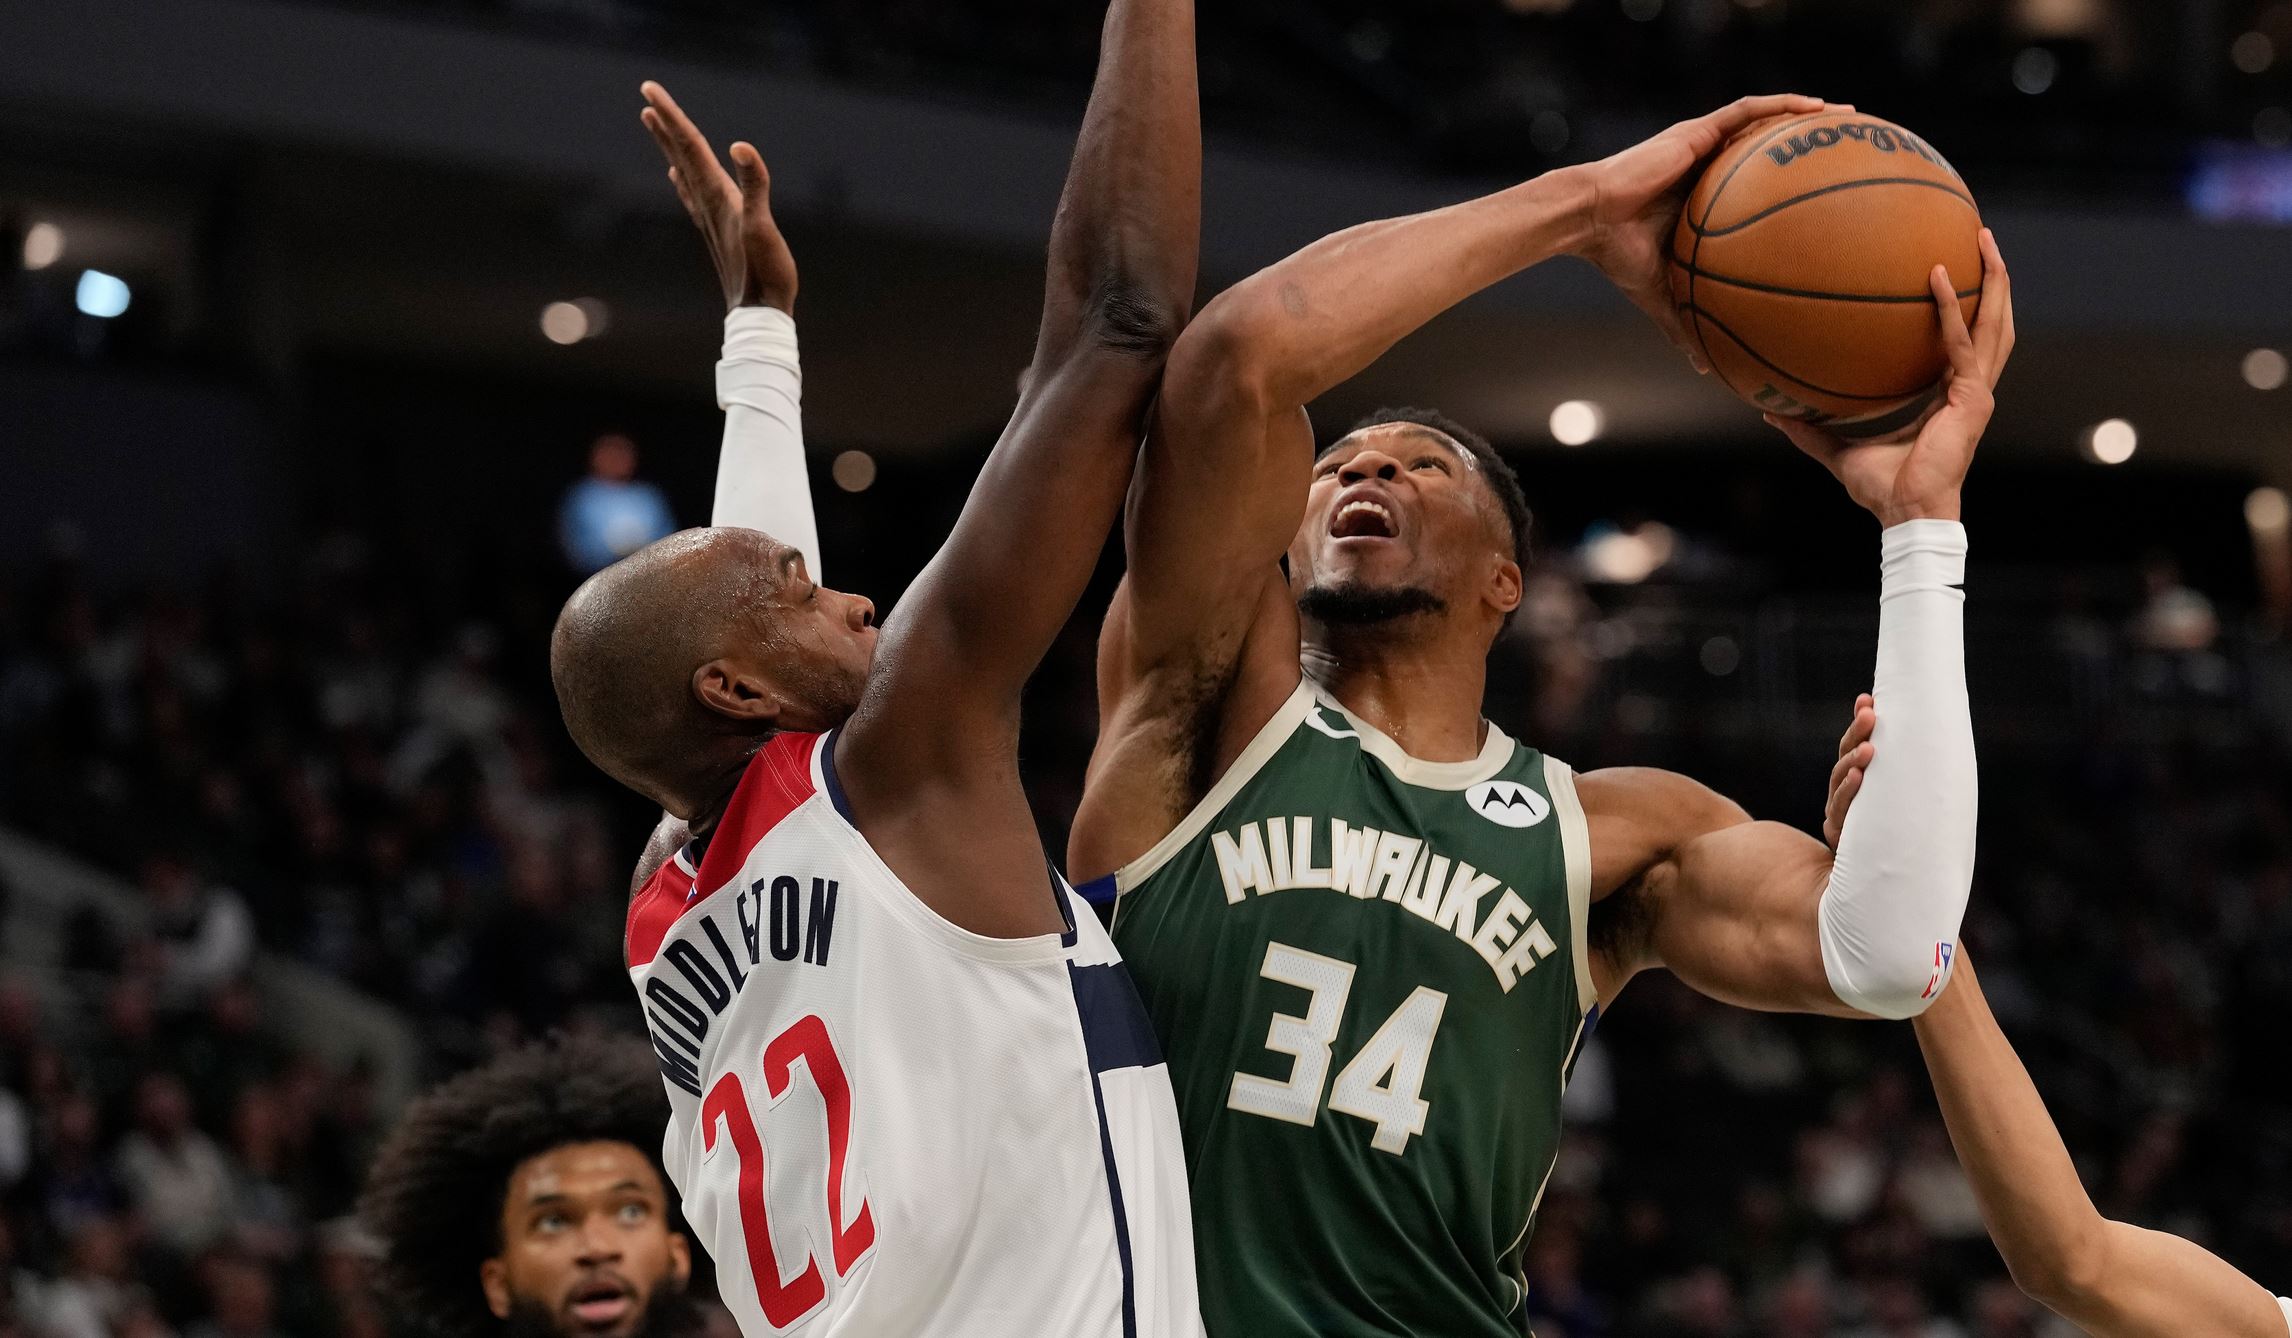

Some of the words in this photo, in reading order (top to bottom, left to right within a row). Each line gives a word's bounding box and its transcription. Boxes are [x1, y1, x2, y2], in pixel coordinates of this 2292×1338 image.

[1211, 815, 1558, 995] MILWAUKEE
[1227, 941, 1449, 1157] 34
[701, 1013, 876, 1330] 22
